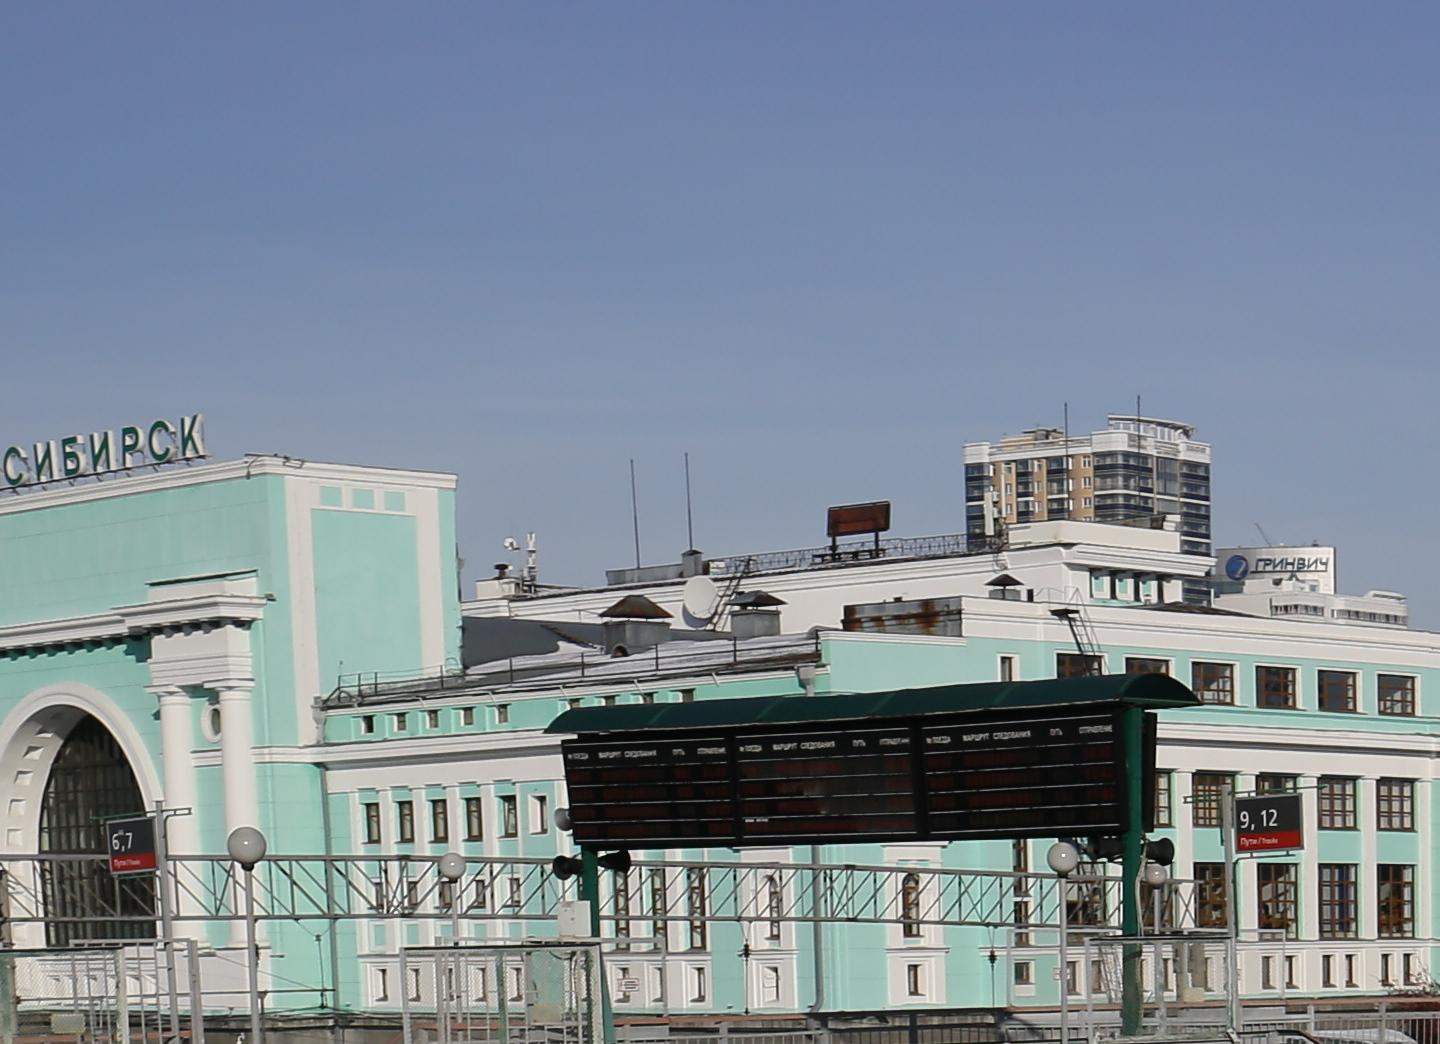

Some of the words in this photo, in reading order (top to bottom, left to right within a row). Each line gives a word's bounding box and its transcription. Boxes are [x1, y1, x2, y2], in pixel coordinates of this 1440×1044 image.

[1255, 557, 1329, 571] ГРИНВИЧ
[1240, 811, 1255, 831] 9,
[1261, 809, 1278, 827] 12
